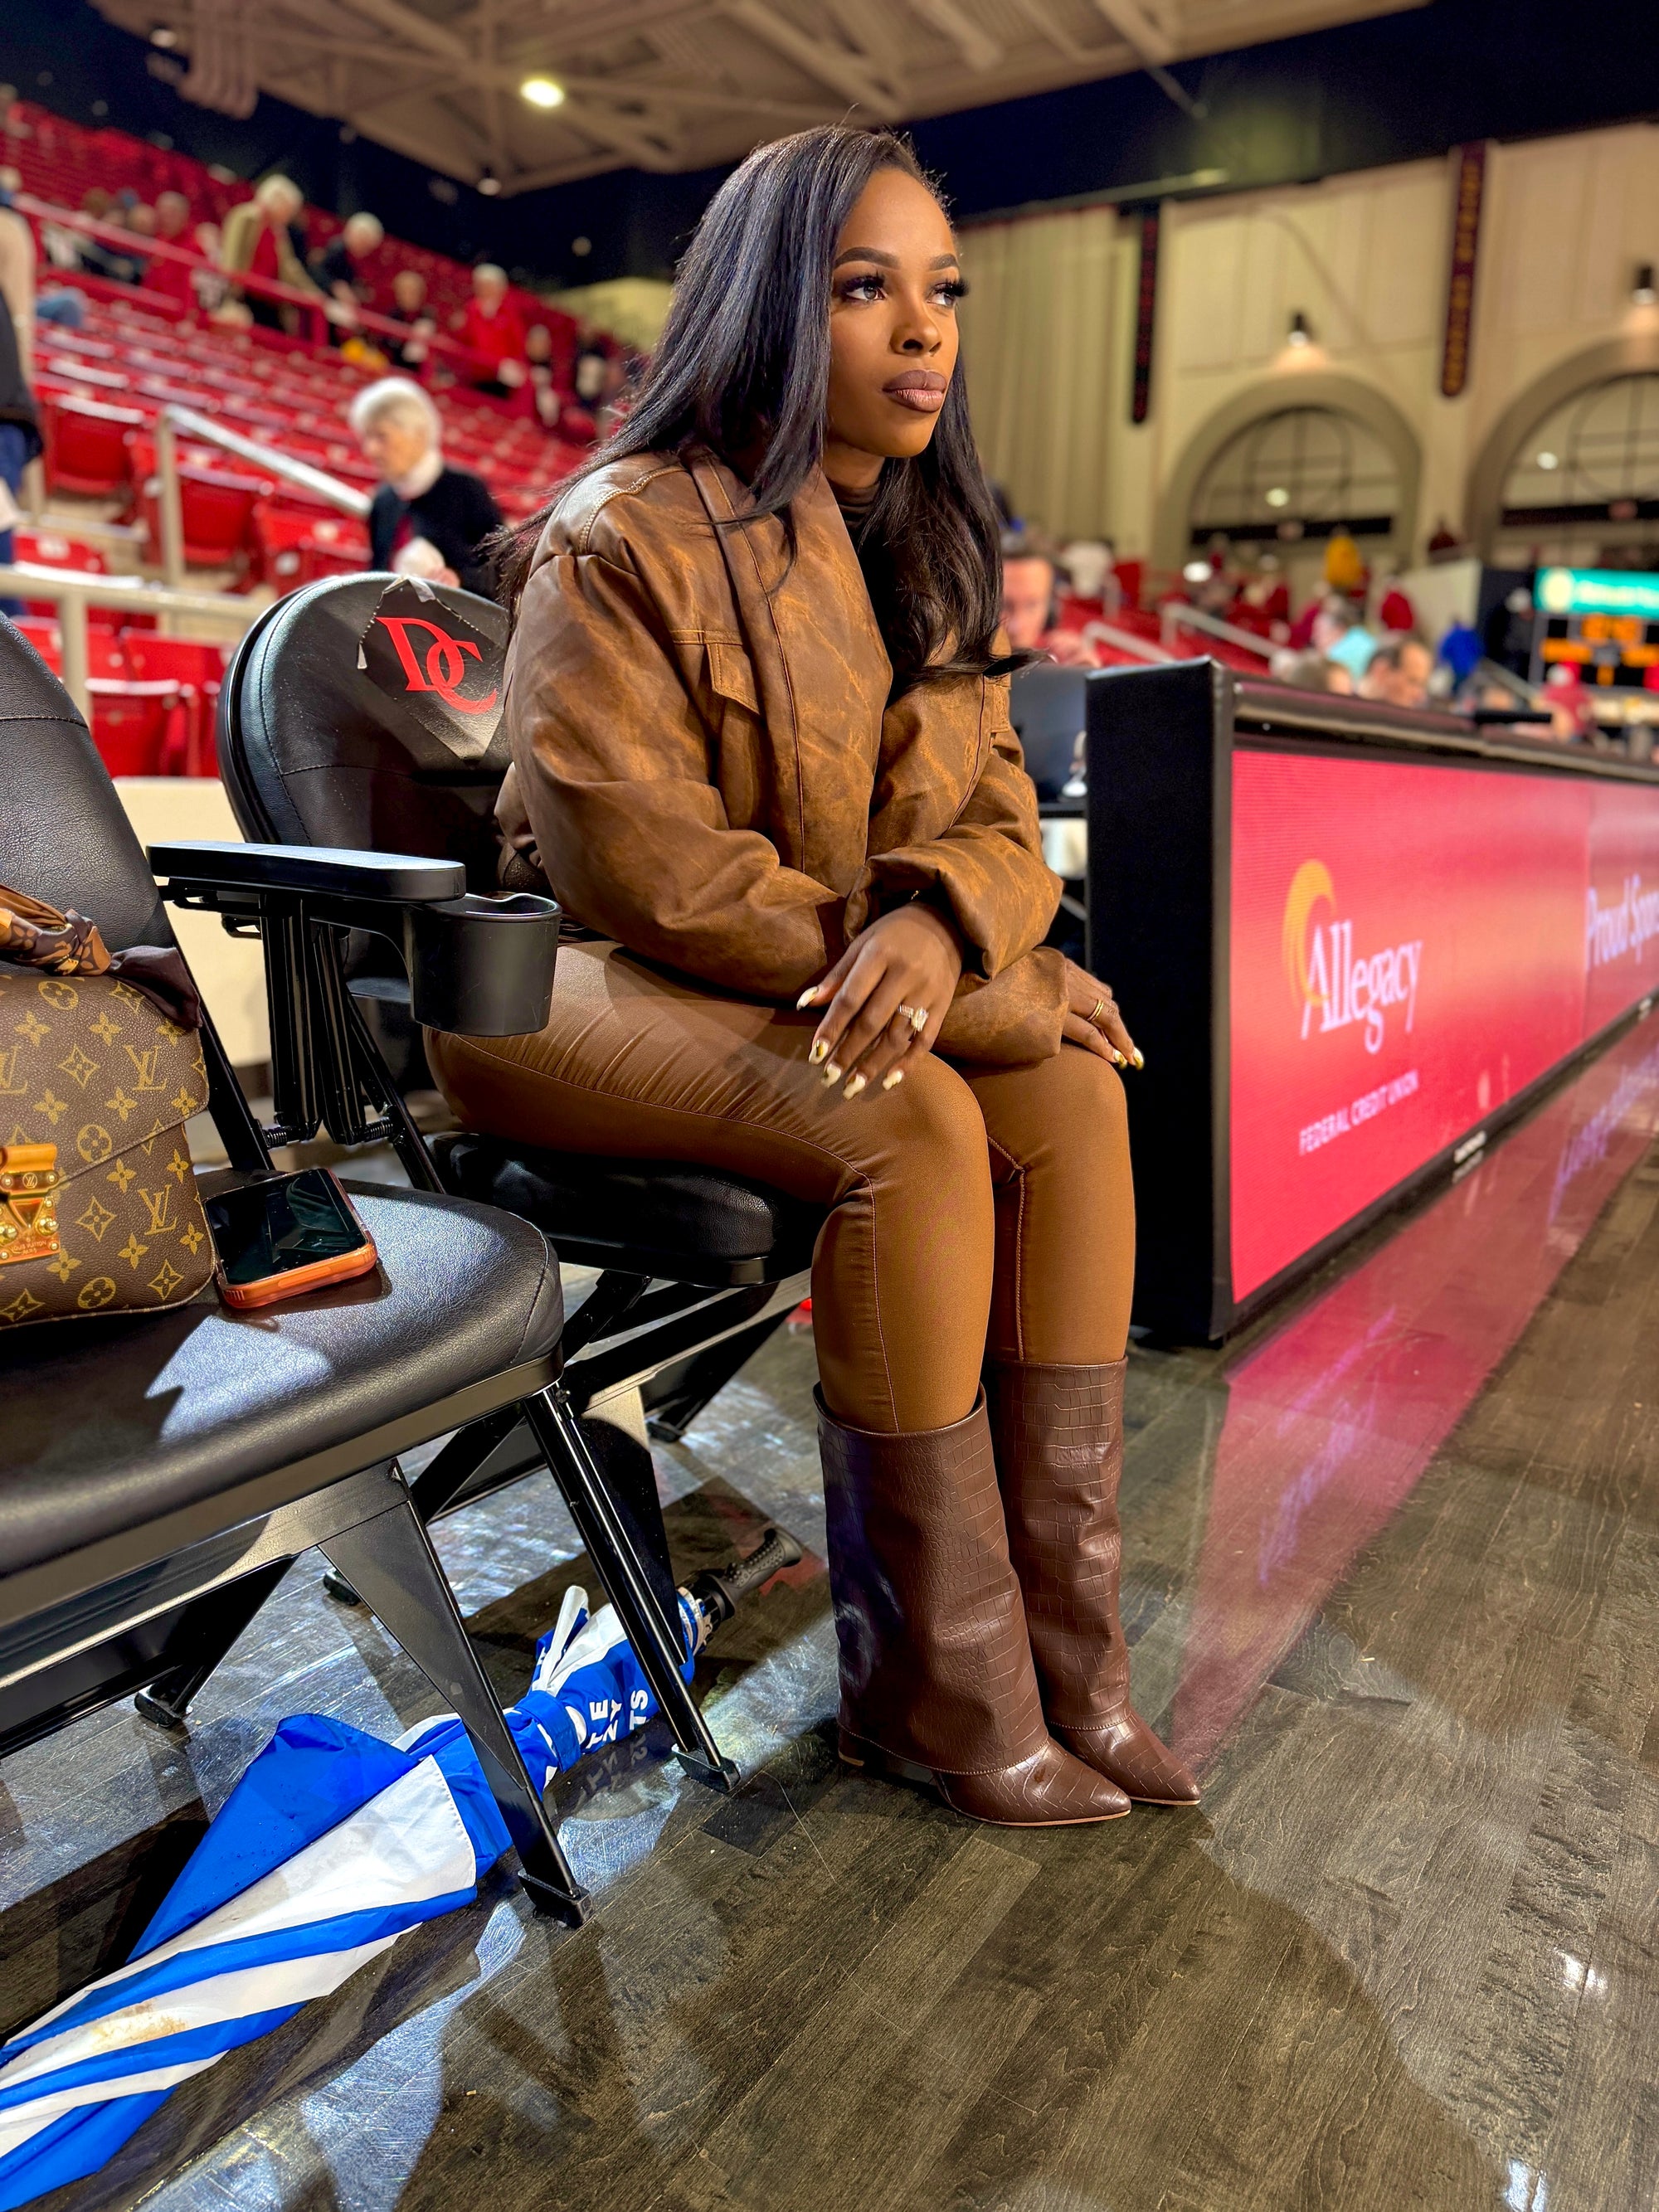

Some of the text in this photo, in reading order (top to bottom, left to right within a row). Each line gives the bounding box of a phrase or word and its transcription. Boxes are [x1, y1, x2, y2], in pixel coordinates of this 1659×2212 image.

[375, 616, 498, 715] DC
[1301, 919, 1423, 1054] Allegacy
[1299, 1107, 1351, 1157] FEDERAL
